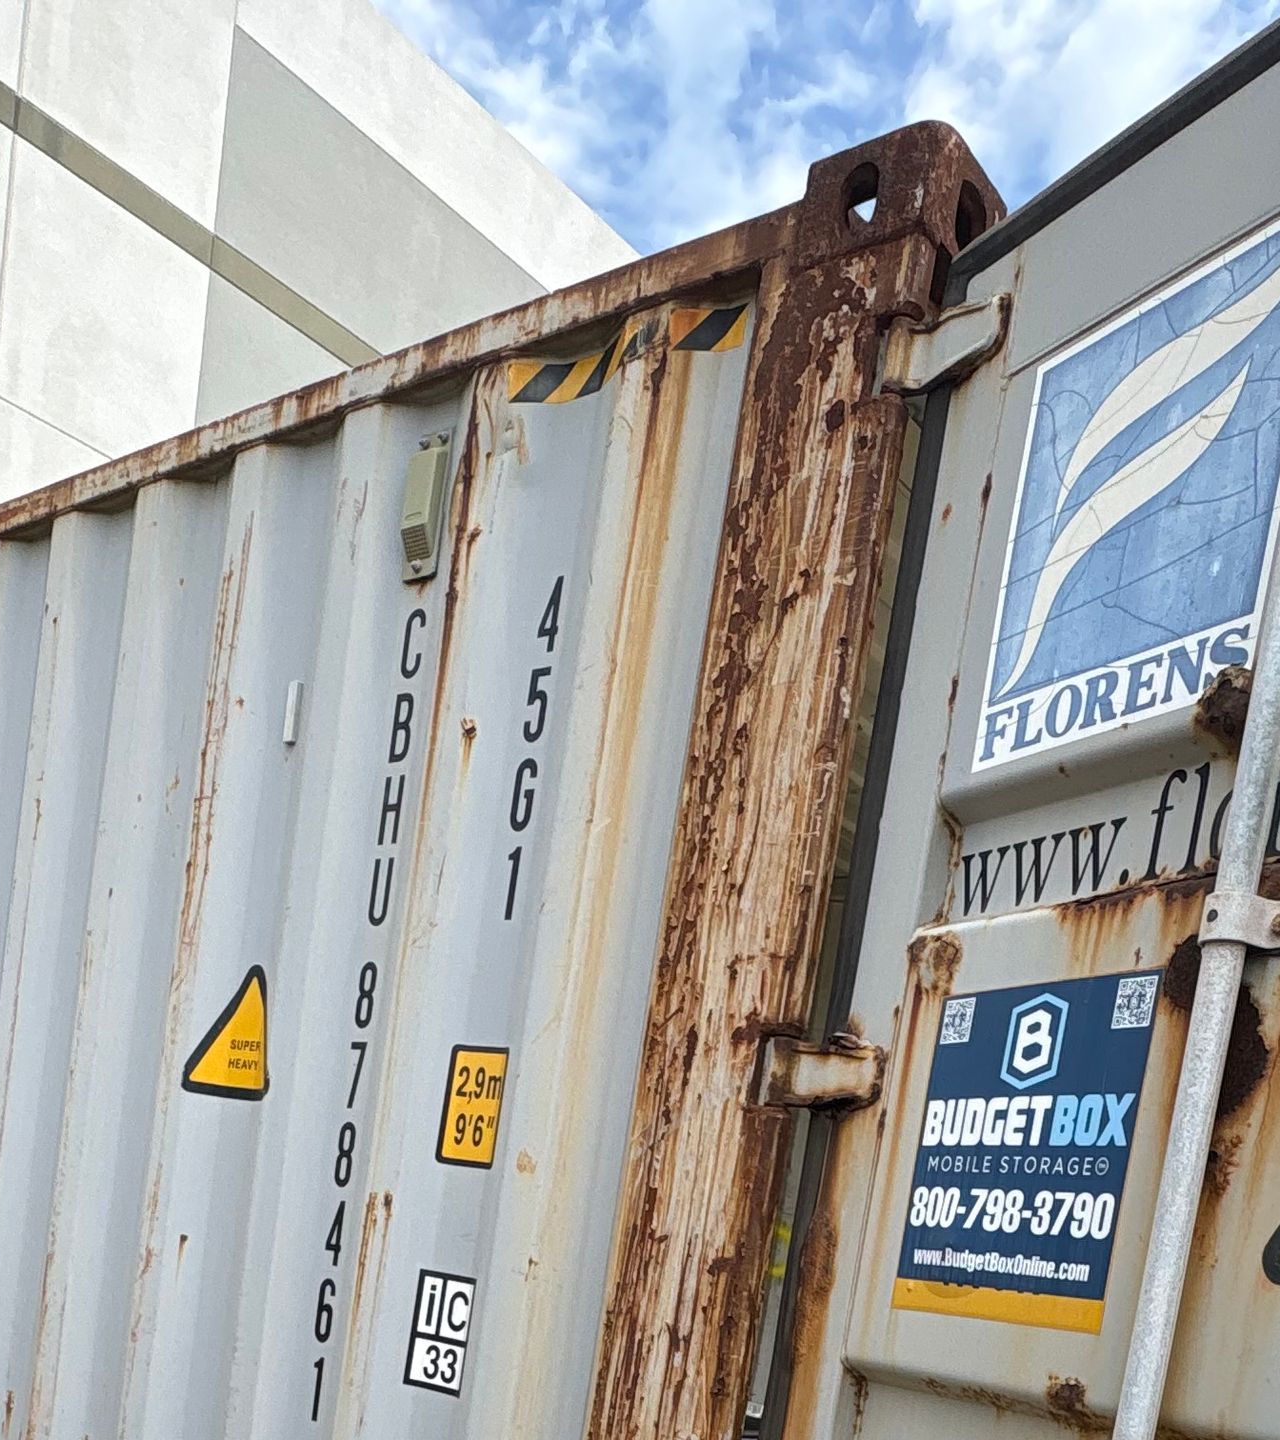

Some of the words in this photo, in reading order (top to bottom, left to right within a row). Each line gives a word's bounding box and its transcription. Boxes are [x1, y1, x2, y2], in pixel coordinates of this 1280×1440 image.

[978, 622, 1252, 763] FLORENS
[367, 607, 427, 927] CBHU
[504, 575, 565, 921] 45G1
[227, 1058, 260, 1071] HEAVY
[311, 961, 378, 1422] 878461
[927, 1155, 992, 1174] MOBILE
[909, 1186, 1116, 1240] 800-798-3790
[912, 1247, 1091, 1283] www.BudgetBoxOnline.com
[423, 1345, 458, 1384] 33
